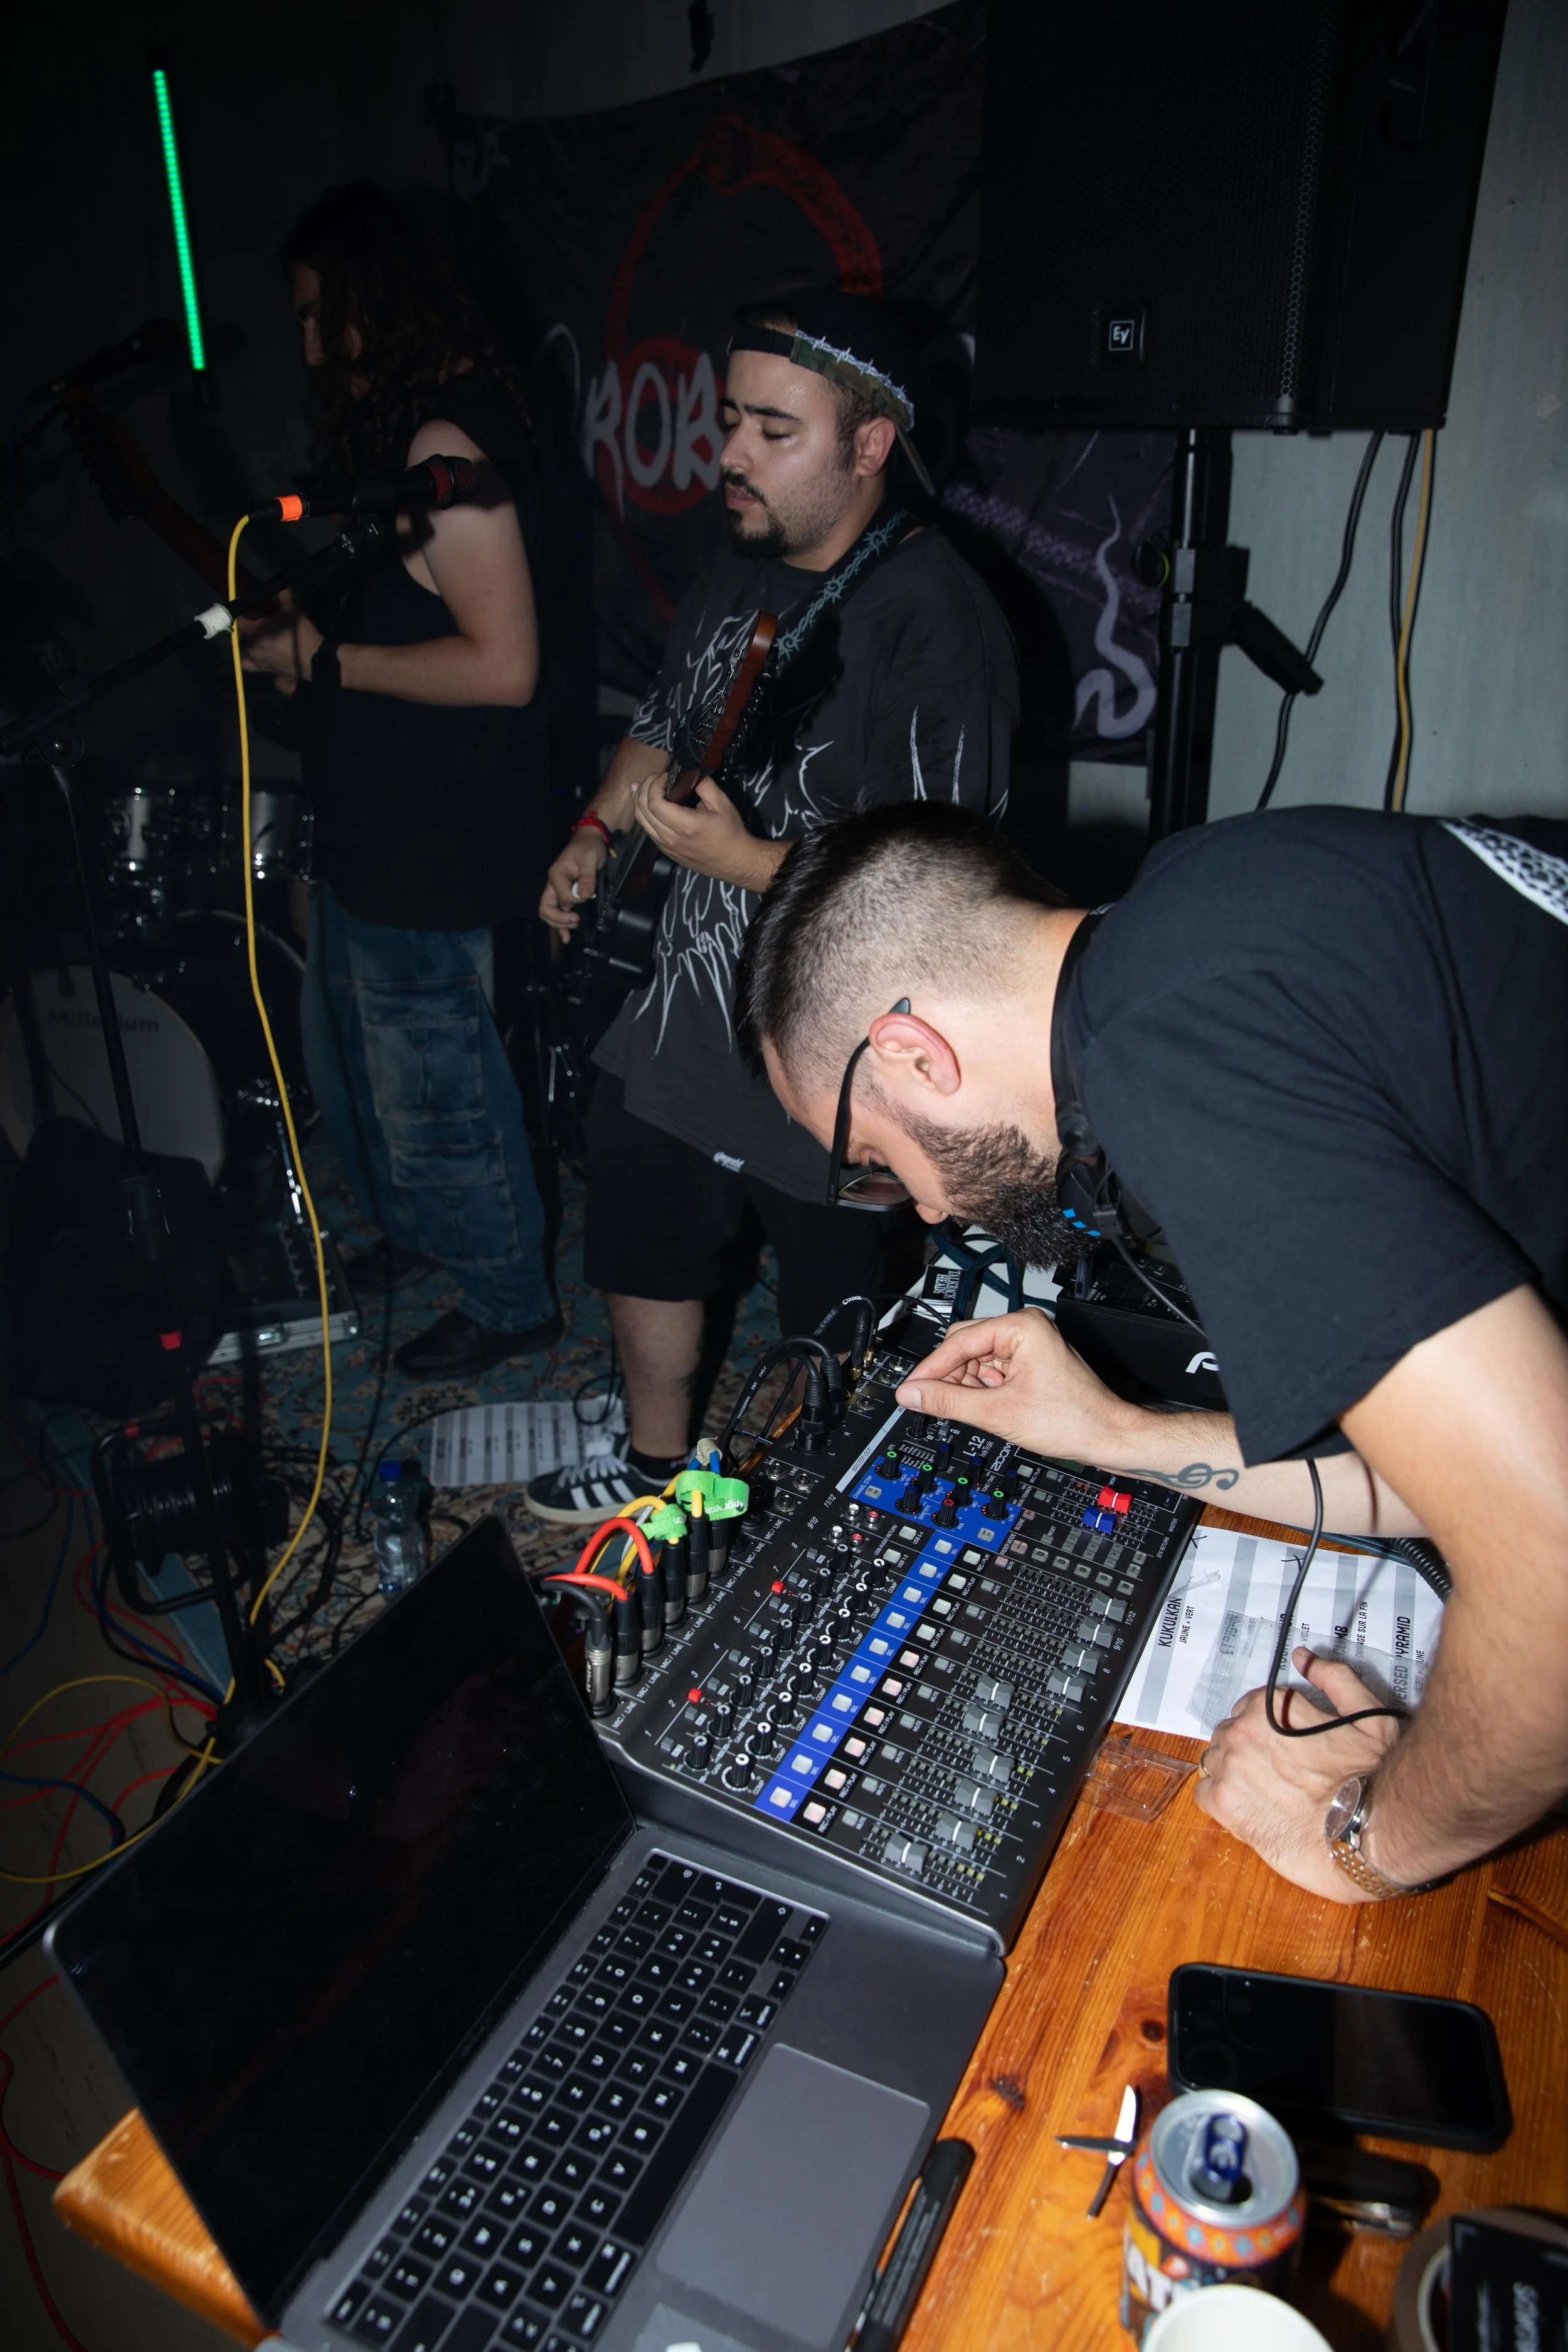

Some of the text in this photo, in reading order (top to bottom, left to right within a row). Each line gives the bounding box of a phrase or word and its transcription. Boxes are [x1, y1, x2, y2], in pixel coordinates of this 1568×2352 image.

[47, 1008, 159, 1032] Milleium
[737, 1395, 751, 1419] PROFESSIONAL
[758, 1365, 767, 1377] CABLE
[963, 1436, 985, 1457] L-12
[979, 1441, 995, 1458] iveTrak
[852, 1448, 872, 1472] MASTER OUT
[990, 1443, 1015, 1471] ZOOM
[789, 1466, 798, 1476] LINE
[946, 1465, 955, 1474] TYPE
[853, 1475, 872, 1499] CHANNEL STRIP
[824, 1493, 837, 1508] 11/12
[772, 1518, 784, 1531] LINE
[807, 1517, 818, 1530] 9/10
[1015, 1518, 1025, 1531] SCENE
[1168, 1518, 1179, 1533] MASTER
[879, 1537, 889, 1549] AUDIO
[887, 1524, 898, 1539] RETURN
[1047, 1525, 1056, 1537] RESET
[753, 1541, 765, 1554] LINE
[1000, 1533, 1017, 1555] FADER MODE
[1157, 1537, 1170, 1559] EFX RETURN
[734, 1565, 746, 1578] LINE
[1007, 1560, 1015, 1571] MUTE
[887, 1581, 898, 1594] COMP
[992, 1585, 1001, 1595] MUTE
[714, 1590, 726, 1604] LINE
[919, 1596, 928, 1604] SEL
[871, 1606, 881, 1619] COMP
[1360, 1601, 1369, 1611] FIN
[977, 1610, 986, 1621] MUTE
[1125, 1611, 1136, 1626] 11/12
[693, 1616, 706, 1629] LINE
[903, 1621, 911, 1629] SEL
[1158, 1597, 1182, 1648] KUKULKAN
[1179, 1625, 1190, 1644] JAUNE
[1185, 1606, 1195, 1619] VERT
[1358, 1621, 1367, 1633] SUR
[853, 1632, 863, 1645] COMP
[962, 1635, 972, 1646] MUTE
[1113, 1638, 1125, 1651] 9/10
[1395, 1616, 1411, 1661] PYRAMID
[671, 1643, 684, 1656] LINE
[713, 1642, 720, 1650] 4
[1355, 1634, 1365, 1658] ORANGE
[835, 1660, 845, 1672] COMP
[648, 1671, 661, 1685] LINE
[691, 1670, 699, 1678] 3
[668, 1698, 677, 1708] 2
[645, 1729, 652, 1737] 1
[1016, 1855, 1025, 1864] 2
